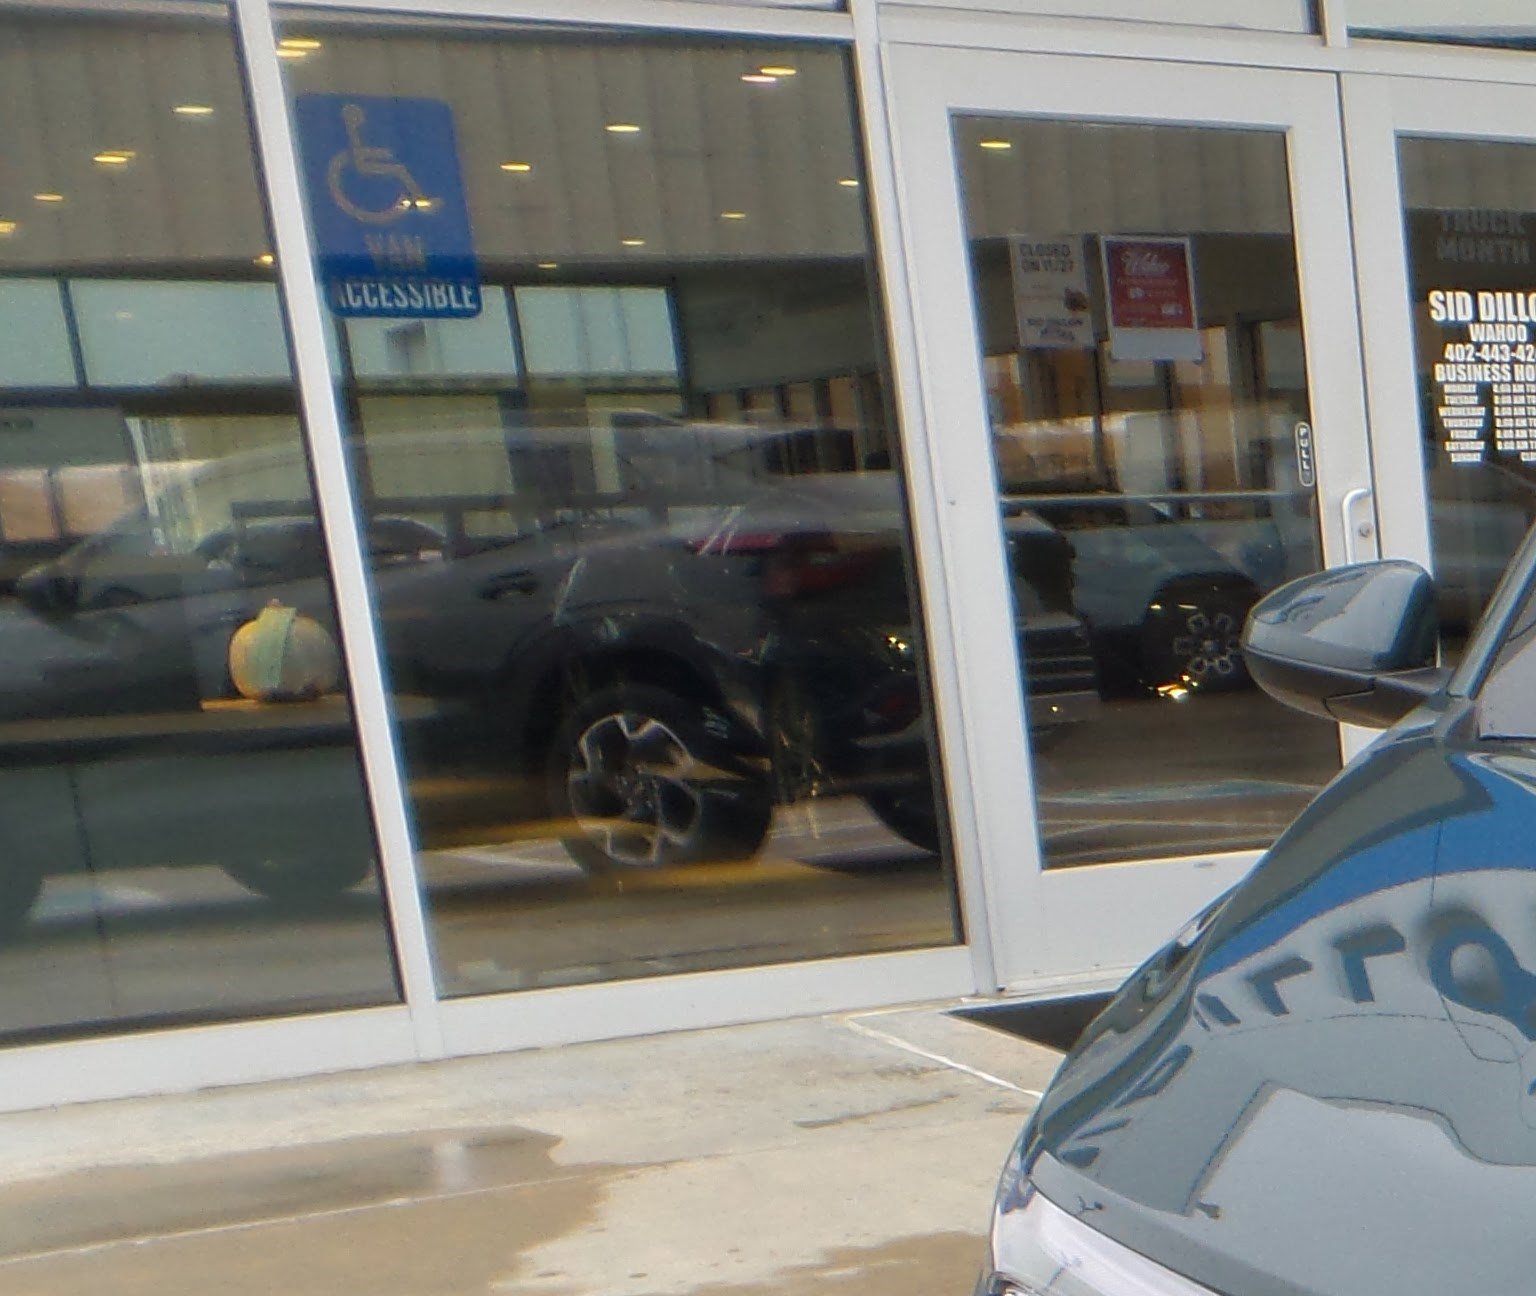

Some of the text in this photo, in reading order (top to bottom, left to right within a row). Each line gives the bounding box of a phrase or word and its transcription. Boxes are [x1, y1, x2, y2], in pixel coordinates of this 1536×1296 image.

[365, 234, 427, 268] VAN
[335, 278, 476, 309] ACCESSIBLE
[1428, 290, 1473, 322] SID
[1469, 324, 1528, 342] WAHOO
[1434, 363, 1512, 382] BUSINESS
